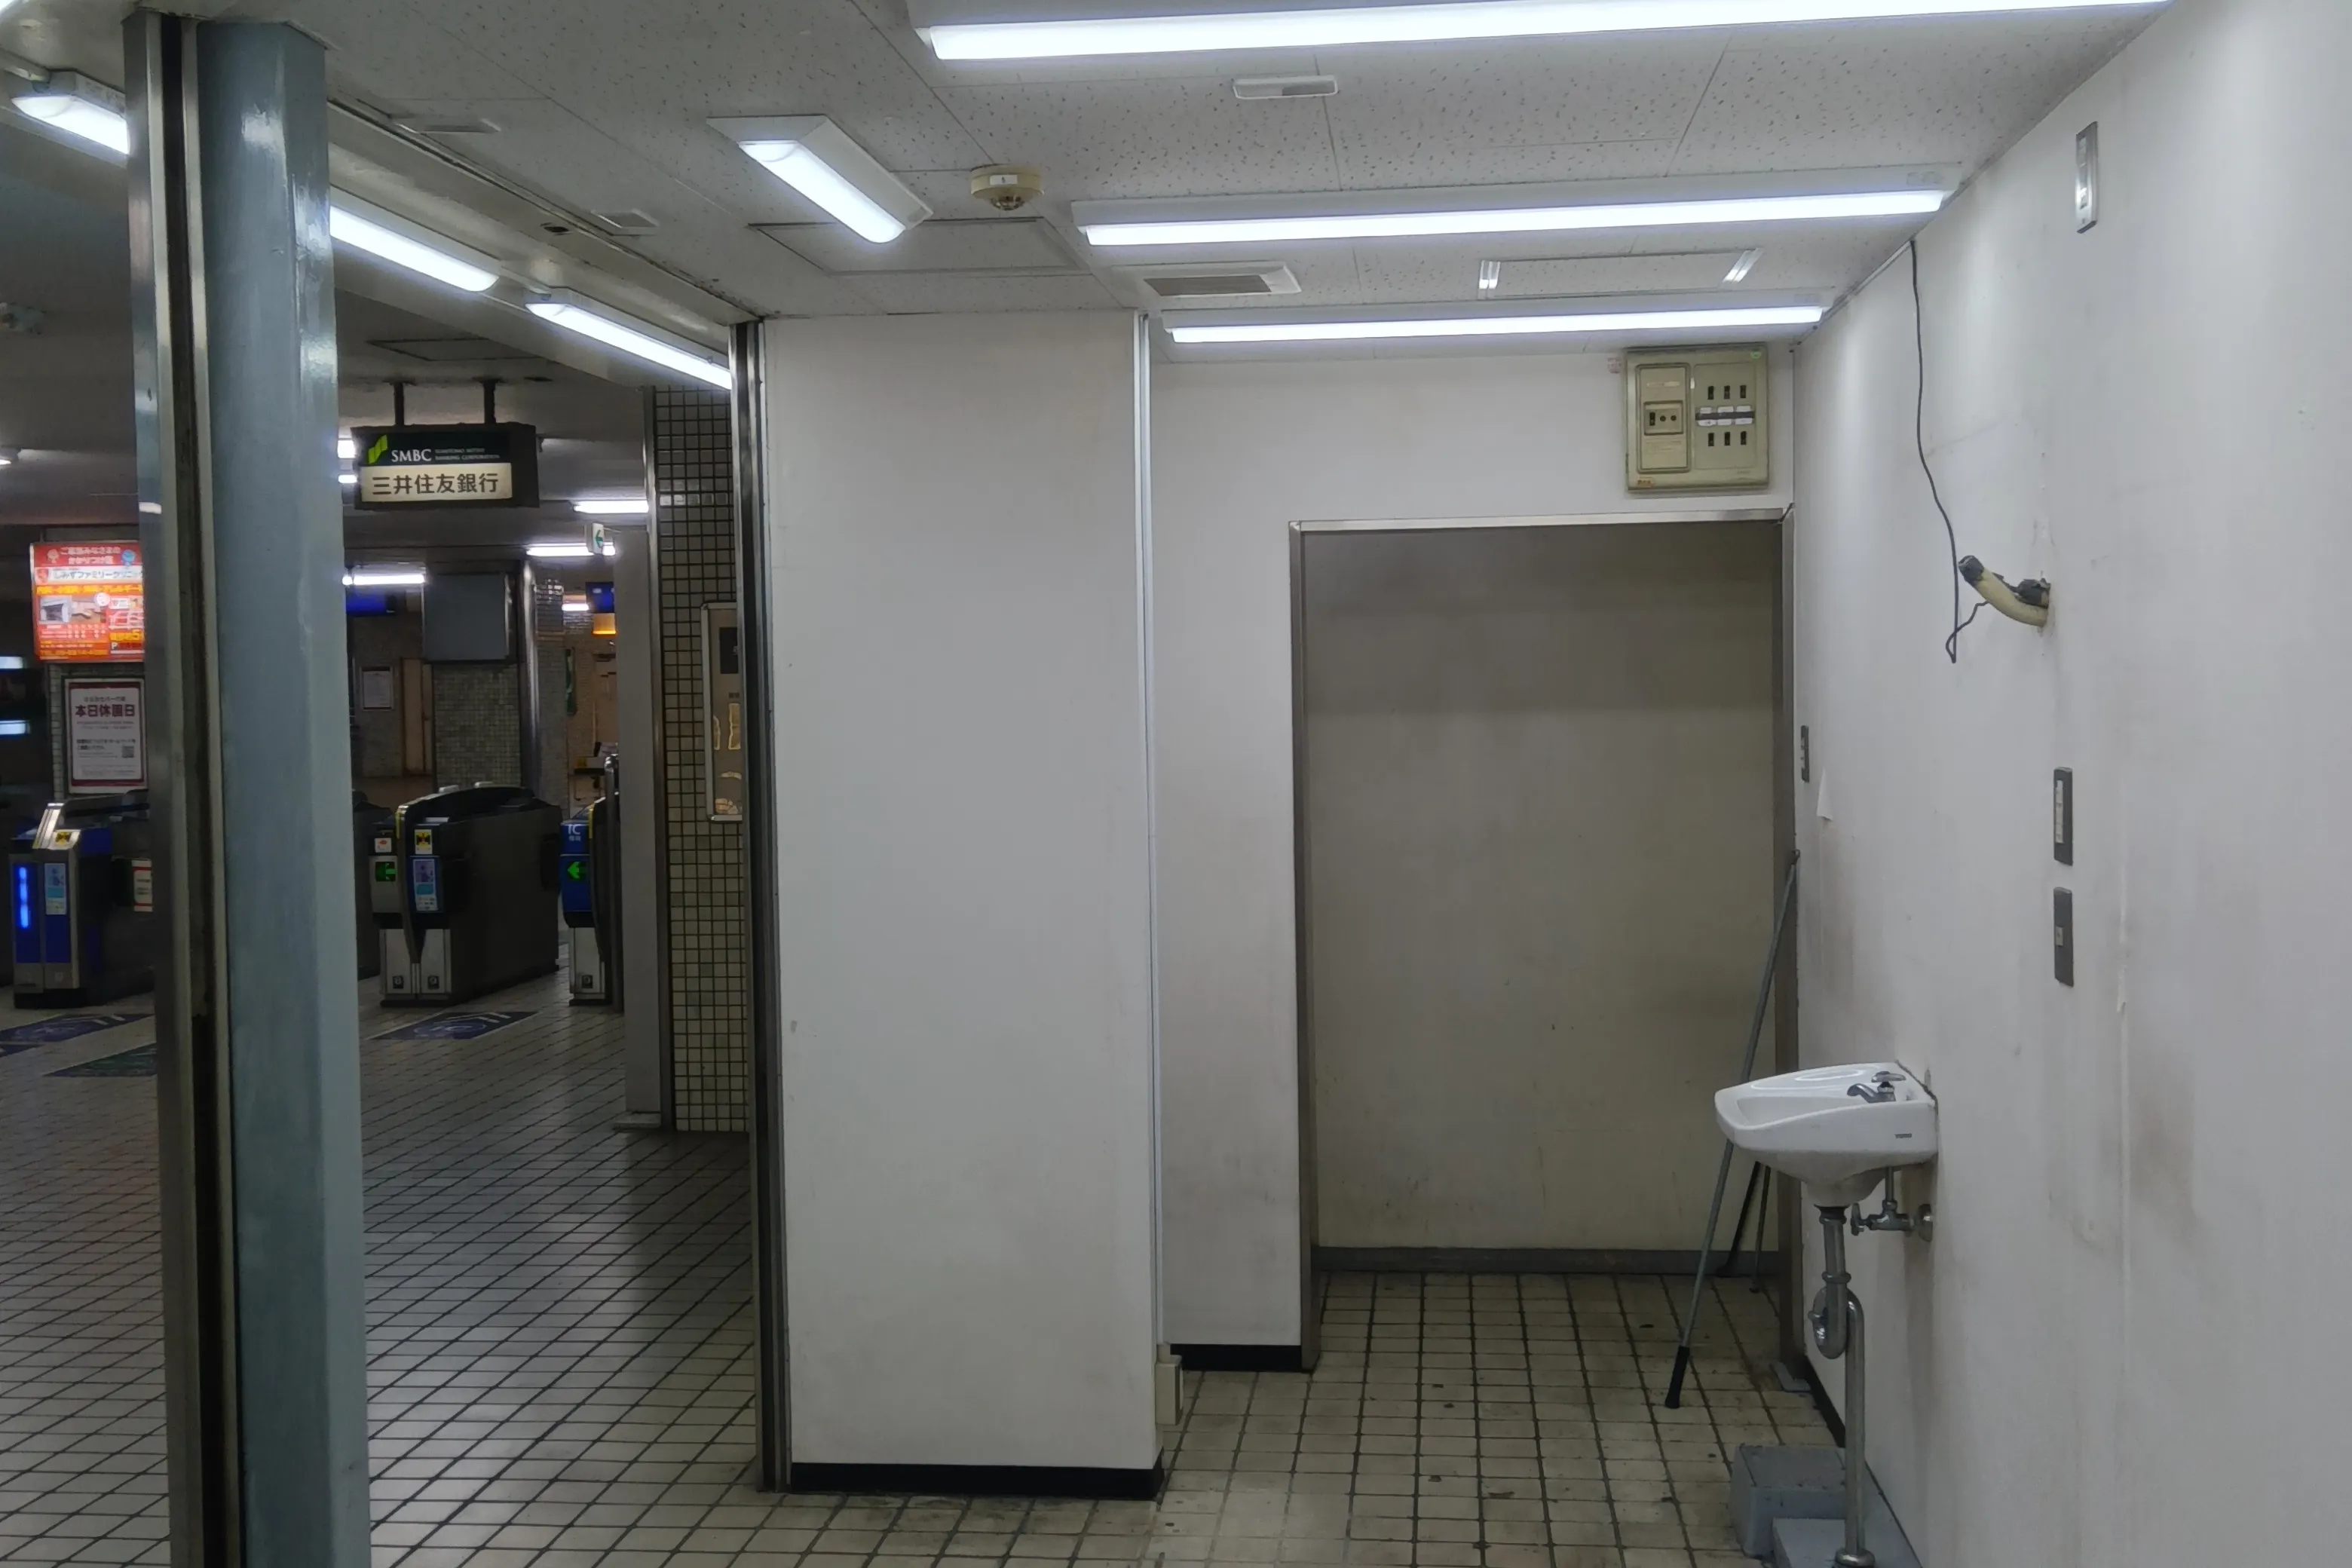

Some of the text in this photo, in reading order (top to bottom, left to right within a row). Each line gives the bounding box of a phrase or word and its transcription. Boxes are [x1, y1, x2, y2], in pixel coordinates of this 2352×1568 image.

[391, 449, 432, 462] SMBC
[372, 473, 499, 495] 三井住友銀行
